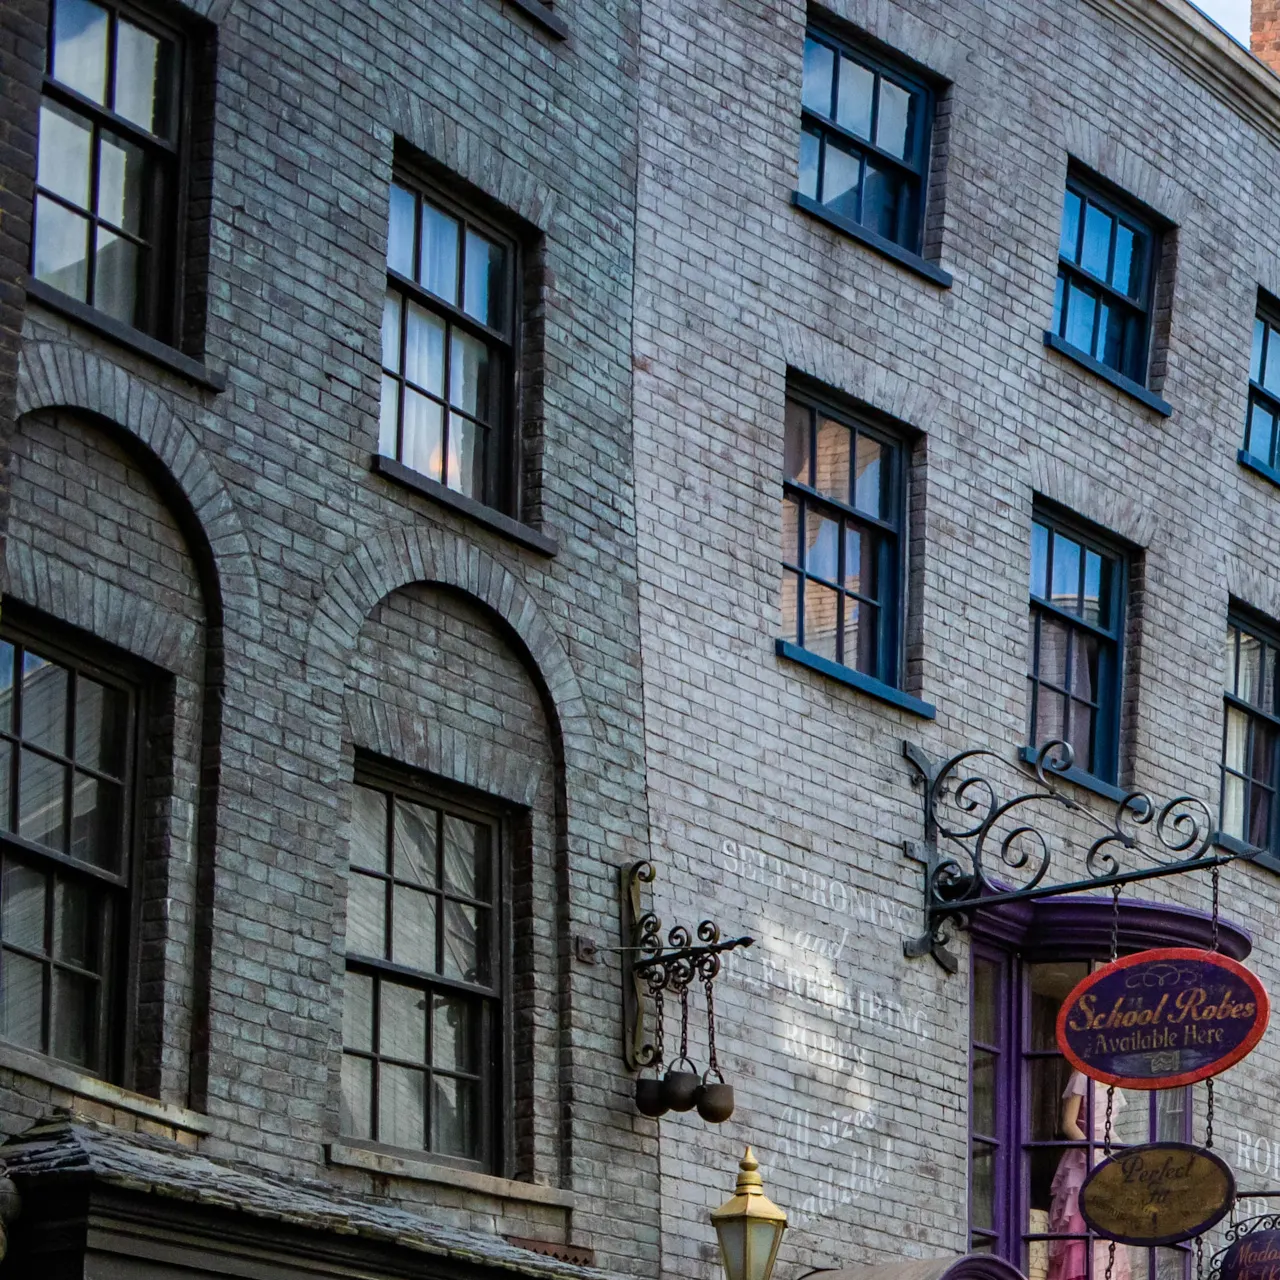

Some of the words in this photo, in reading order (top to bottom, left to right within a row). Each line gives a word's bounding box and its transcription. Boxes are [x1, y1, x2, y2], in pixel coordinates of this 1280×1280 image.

[1068, 992, 1170, 1032] School
[1167, 986, 1256, 1024] Robes
[1094, 1026, 1178, 1055] Available
[1183, 1024, 1225, 1046] Here
